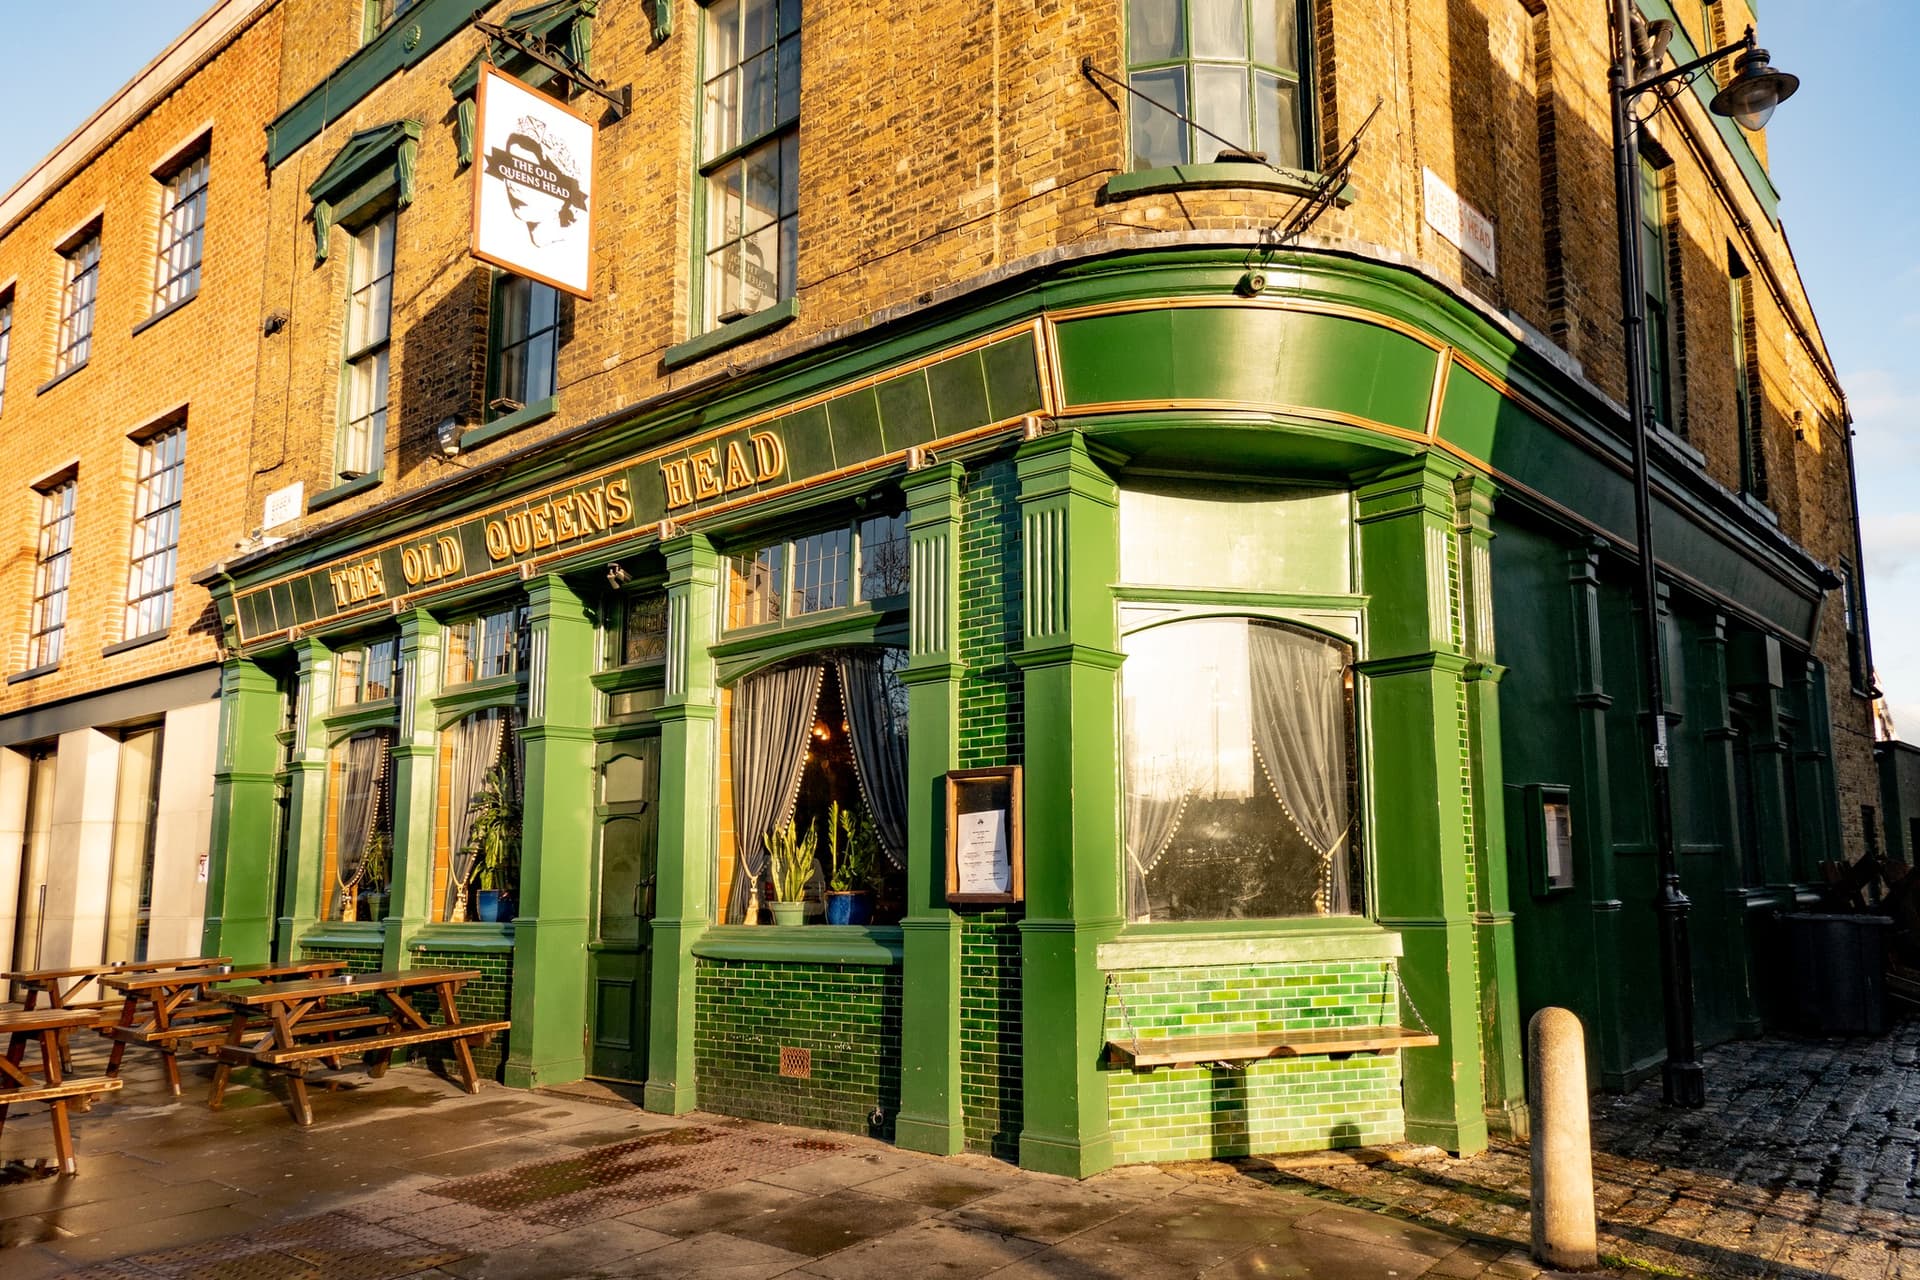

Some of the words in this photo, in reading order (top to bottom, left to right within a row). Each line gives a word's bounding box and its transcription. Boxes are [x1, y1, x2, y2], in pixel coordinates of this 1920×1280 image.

[499, 164, 540, 188] QUEENS
[542, 182, 570, 199] HEAD
[512, 157, 533, 174] THE
[535, 165, 557, 183] OLD
[1467, 219, 1491, 251] HEAD
[330, 558, 384, 606] THE
[401, 535, 462, 585] OLD
[485, 478, 633, 561] QUEENS
[661, 430, 786, 509] HEAD
